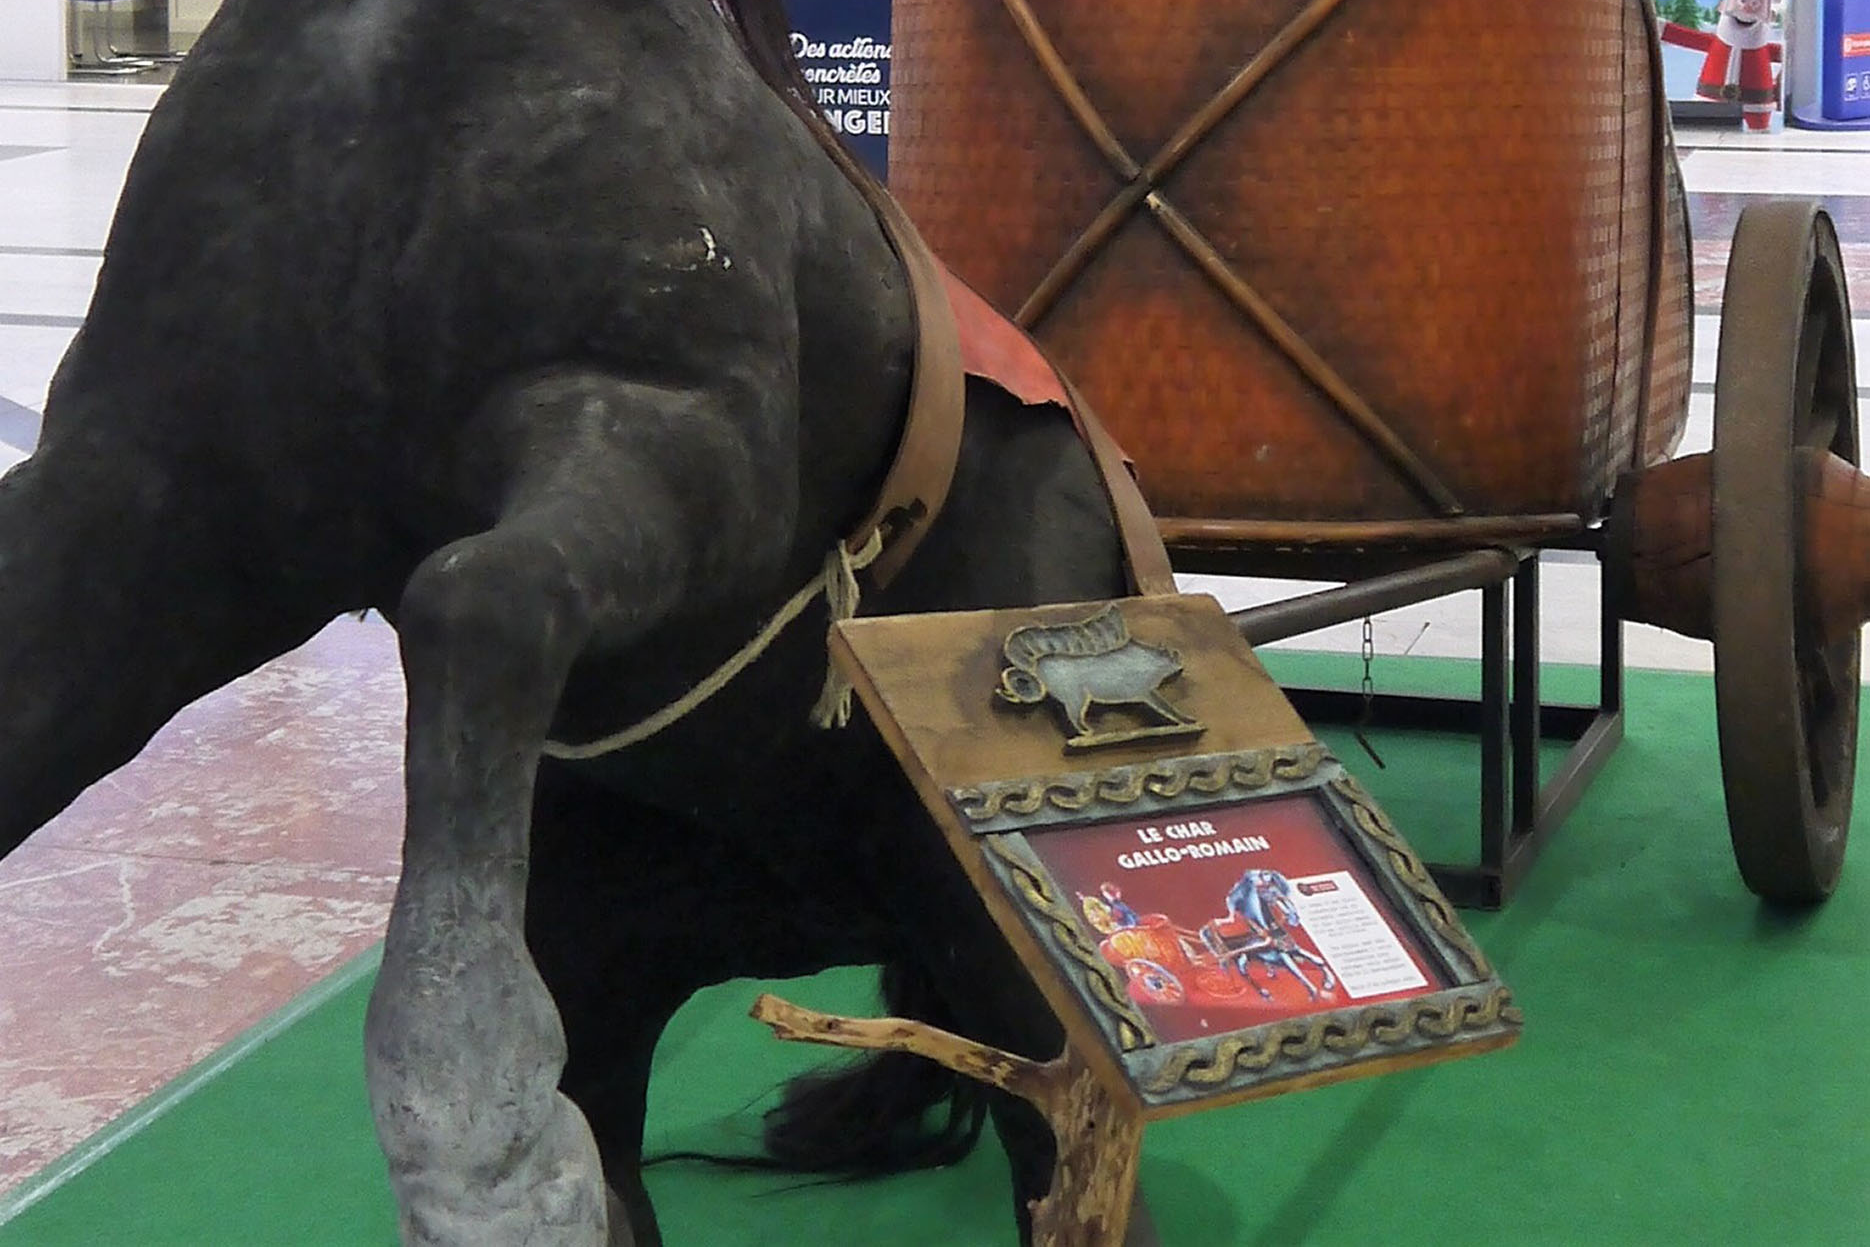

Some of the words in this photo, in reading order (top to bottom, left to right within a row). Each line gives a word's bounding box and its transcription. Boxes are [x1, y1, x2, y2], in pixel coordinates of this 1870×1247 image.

[790, 32, 826, 60] Des
[801, 62, 881, 84] oncrètes
[837, 89, 892, 106] MIEUX
[1136, 827, 1164, 845] LE
[1165, 820, 1218, 840] CHAR
